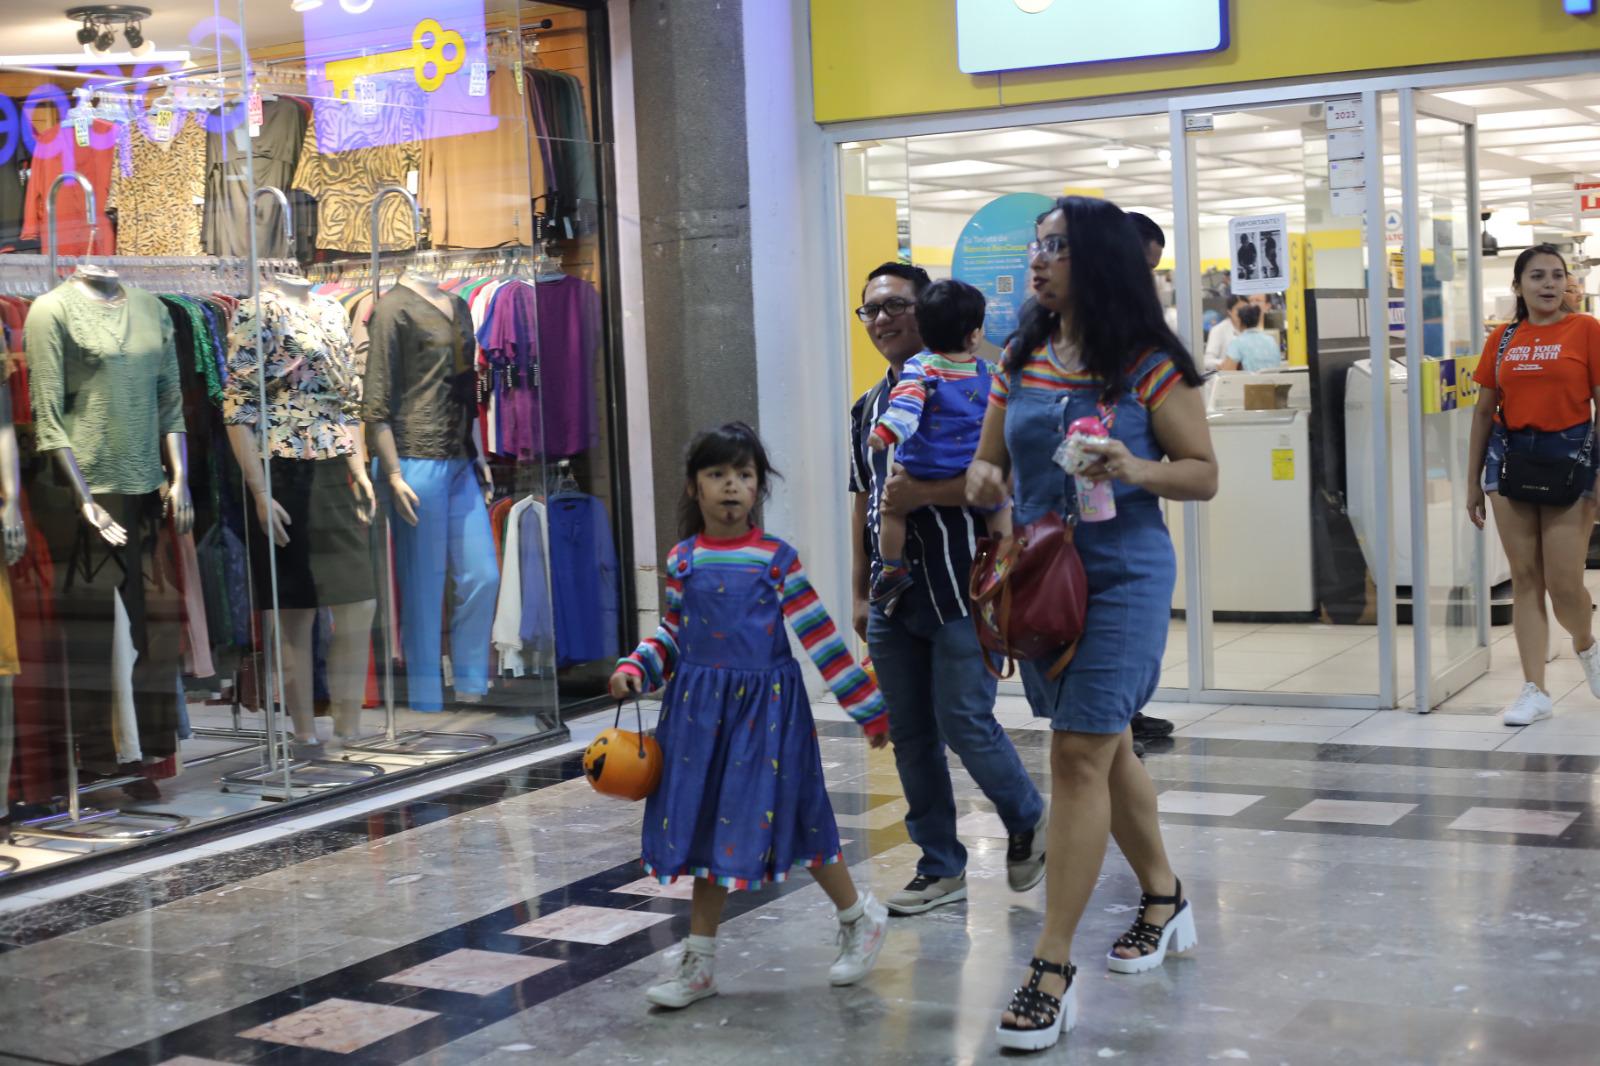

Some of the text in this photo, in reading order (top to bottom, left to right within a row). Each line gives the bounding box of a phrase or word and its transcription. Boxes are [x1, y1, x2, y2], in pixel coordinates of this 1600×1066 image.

[1335, 110, 1357, 120] 2023
[1534, 344, 1562, 354] YOUR
[1532, 352, 1559, 361] PATH
